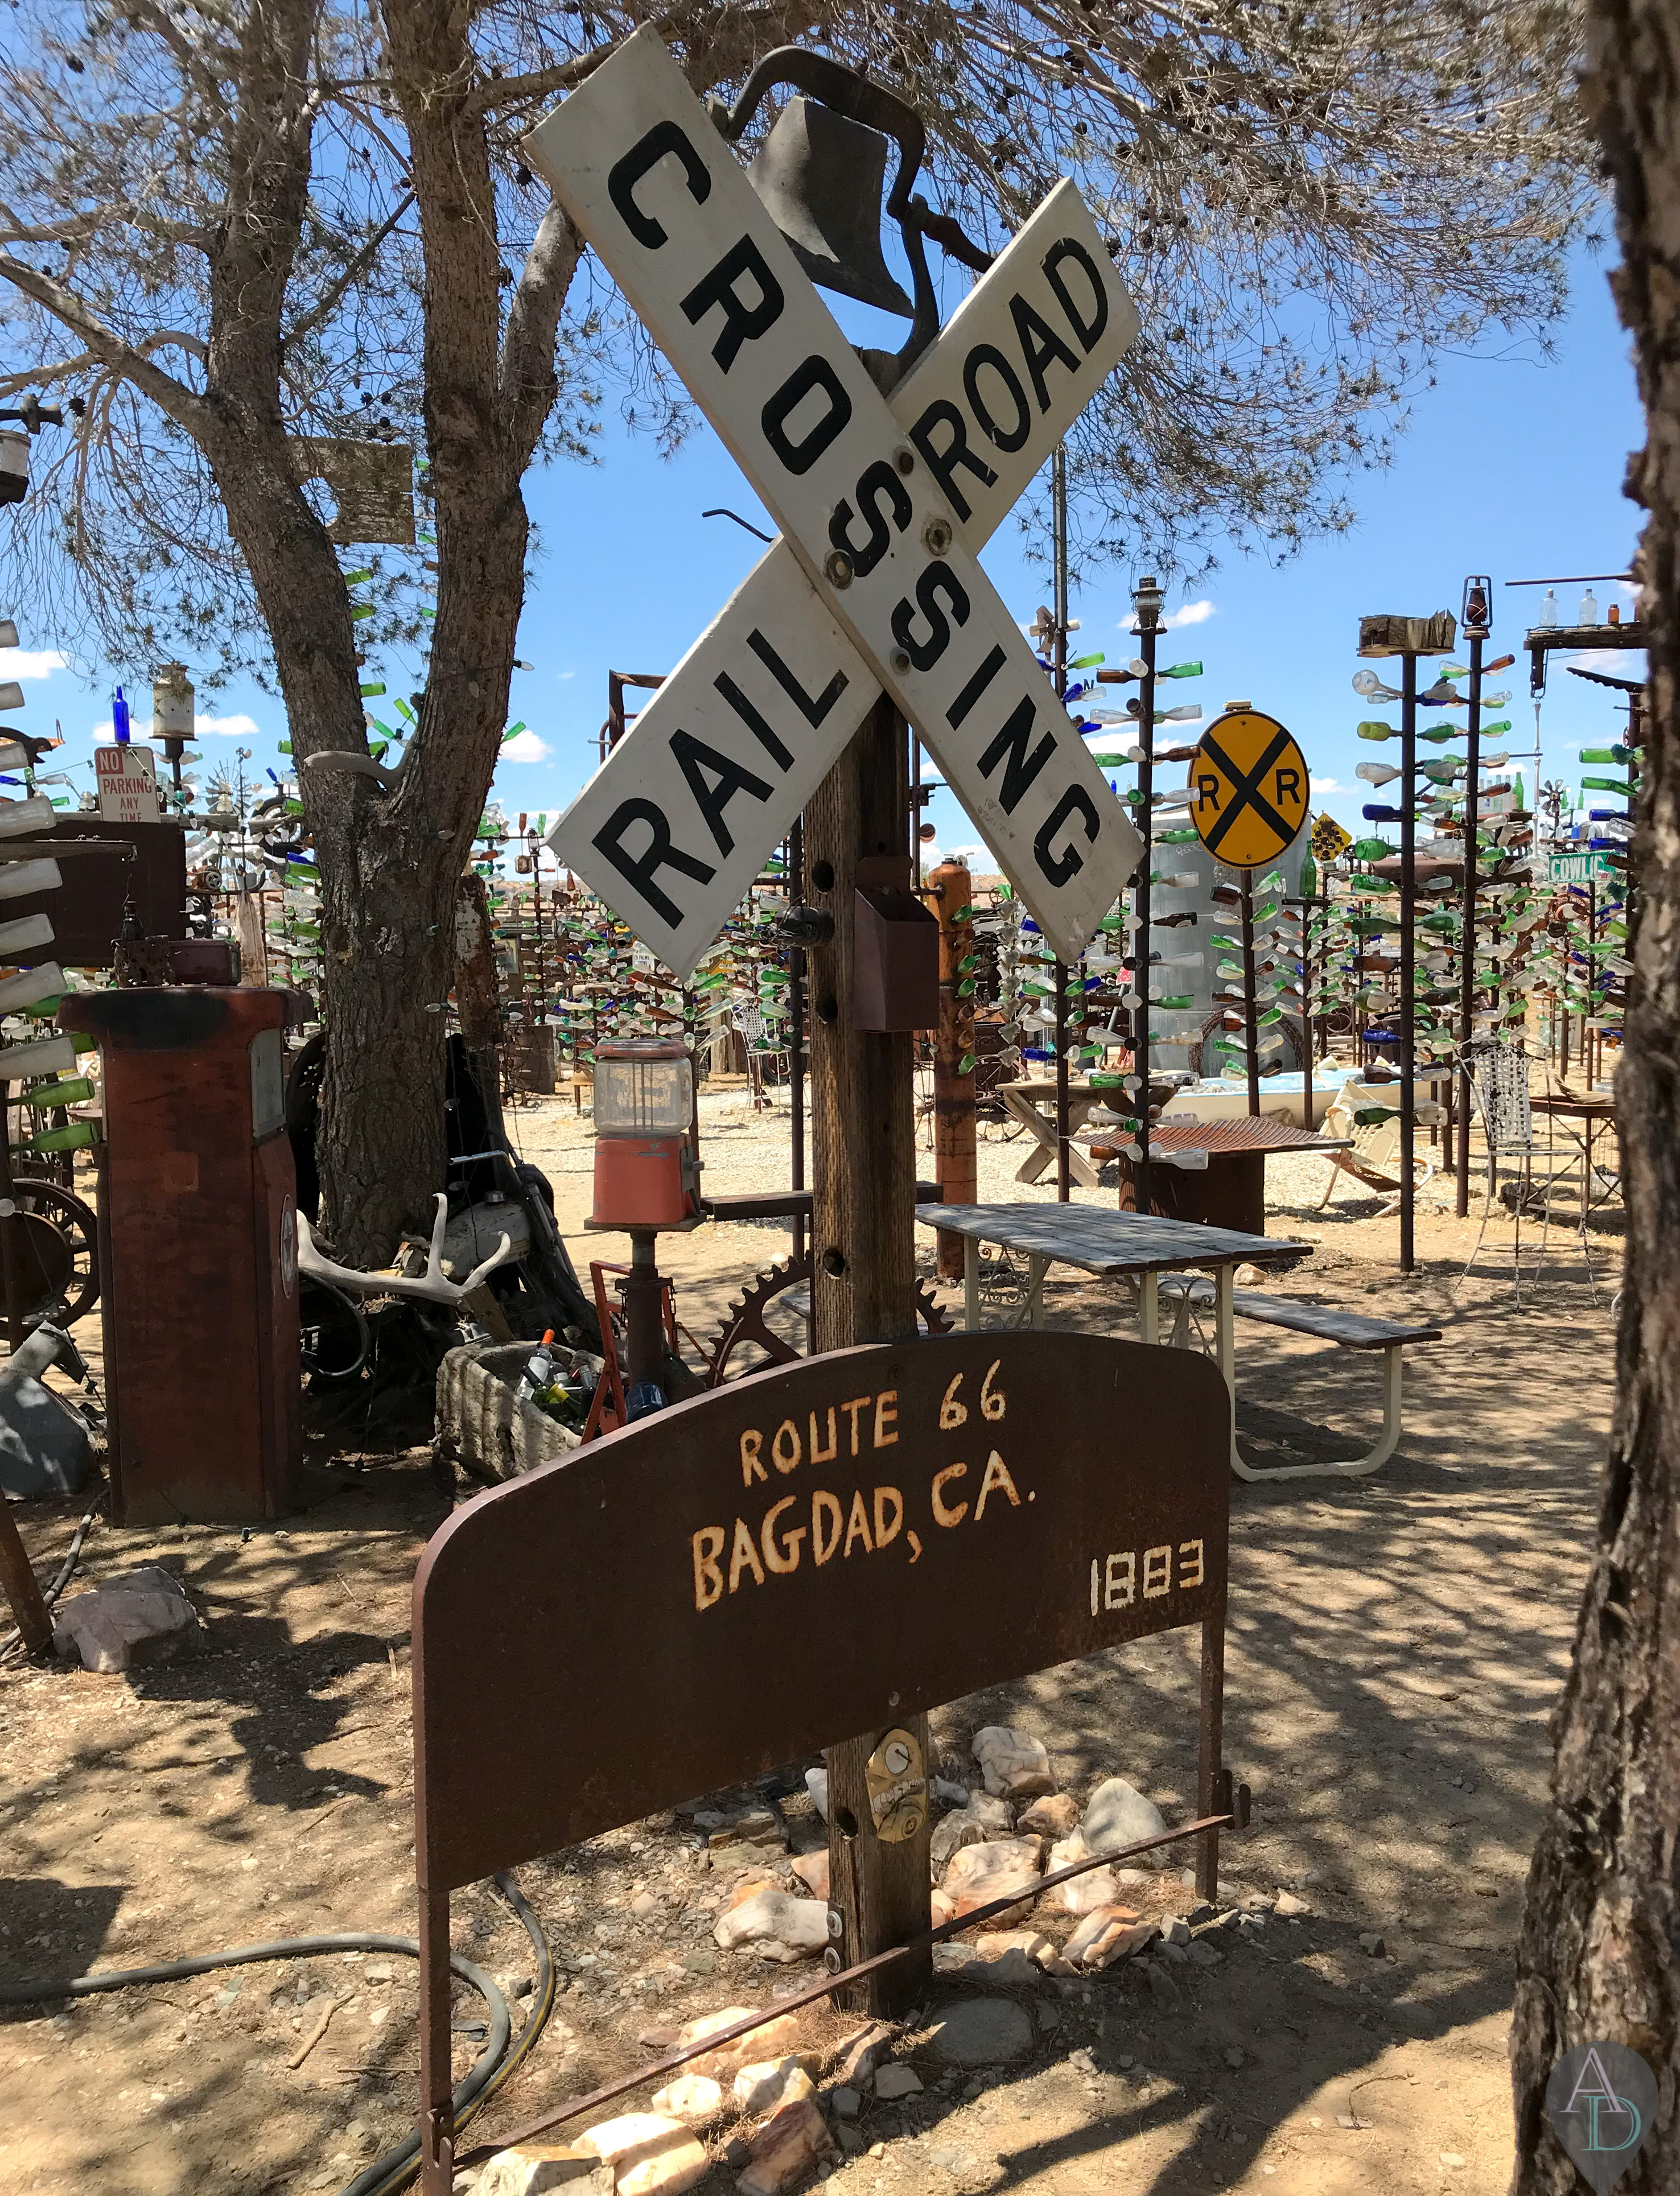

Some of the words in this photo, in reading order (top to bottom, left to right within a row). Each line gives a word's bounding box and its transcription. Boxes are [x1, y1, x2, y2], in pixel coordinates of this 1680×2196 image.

[608, 121, 1100, 887] CROSSING
[591, 628, 850, 930] RAIL
[908, 237, 1108, 524] ROAD
[100, 751, 119, 771] NO
[103, 777, 152, 794] PARKING
[1276, 769, 1301, 805] R
[120, 797, 138, 809] ANY
[740, 1390, 899, 1486] ROUTE
[939, 1359, 1006, 1429] 66
[691, 1486, 923, 1612] BAGDAD,
[932, 1449, 1036, 1528] CA.
[1090, 1539, 1204, 1616] 1883
